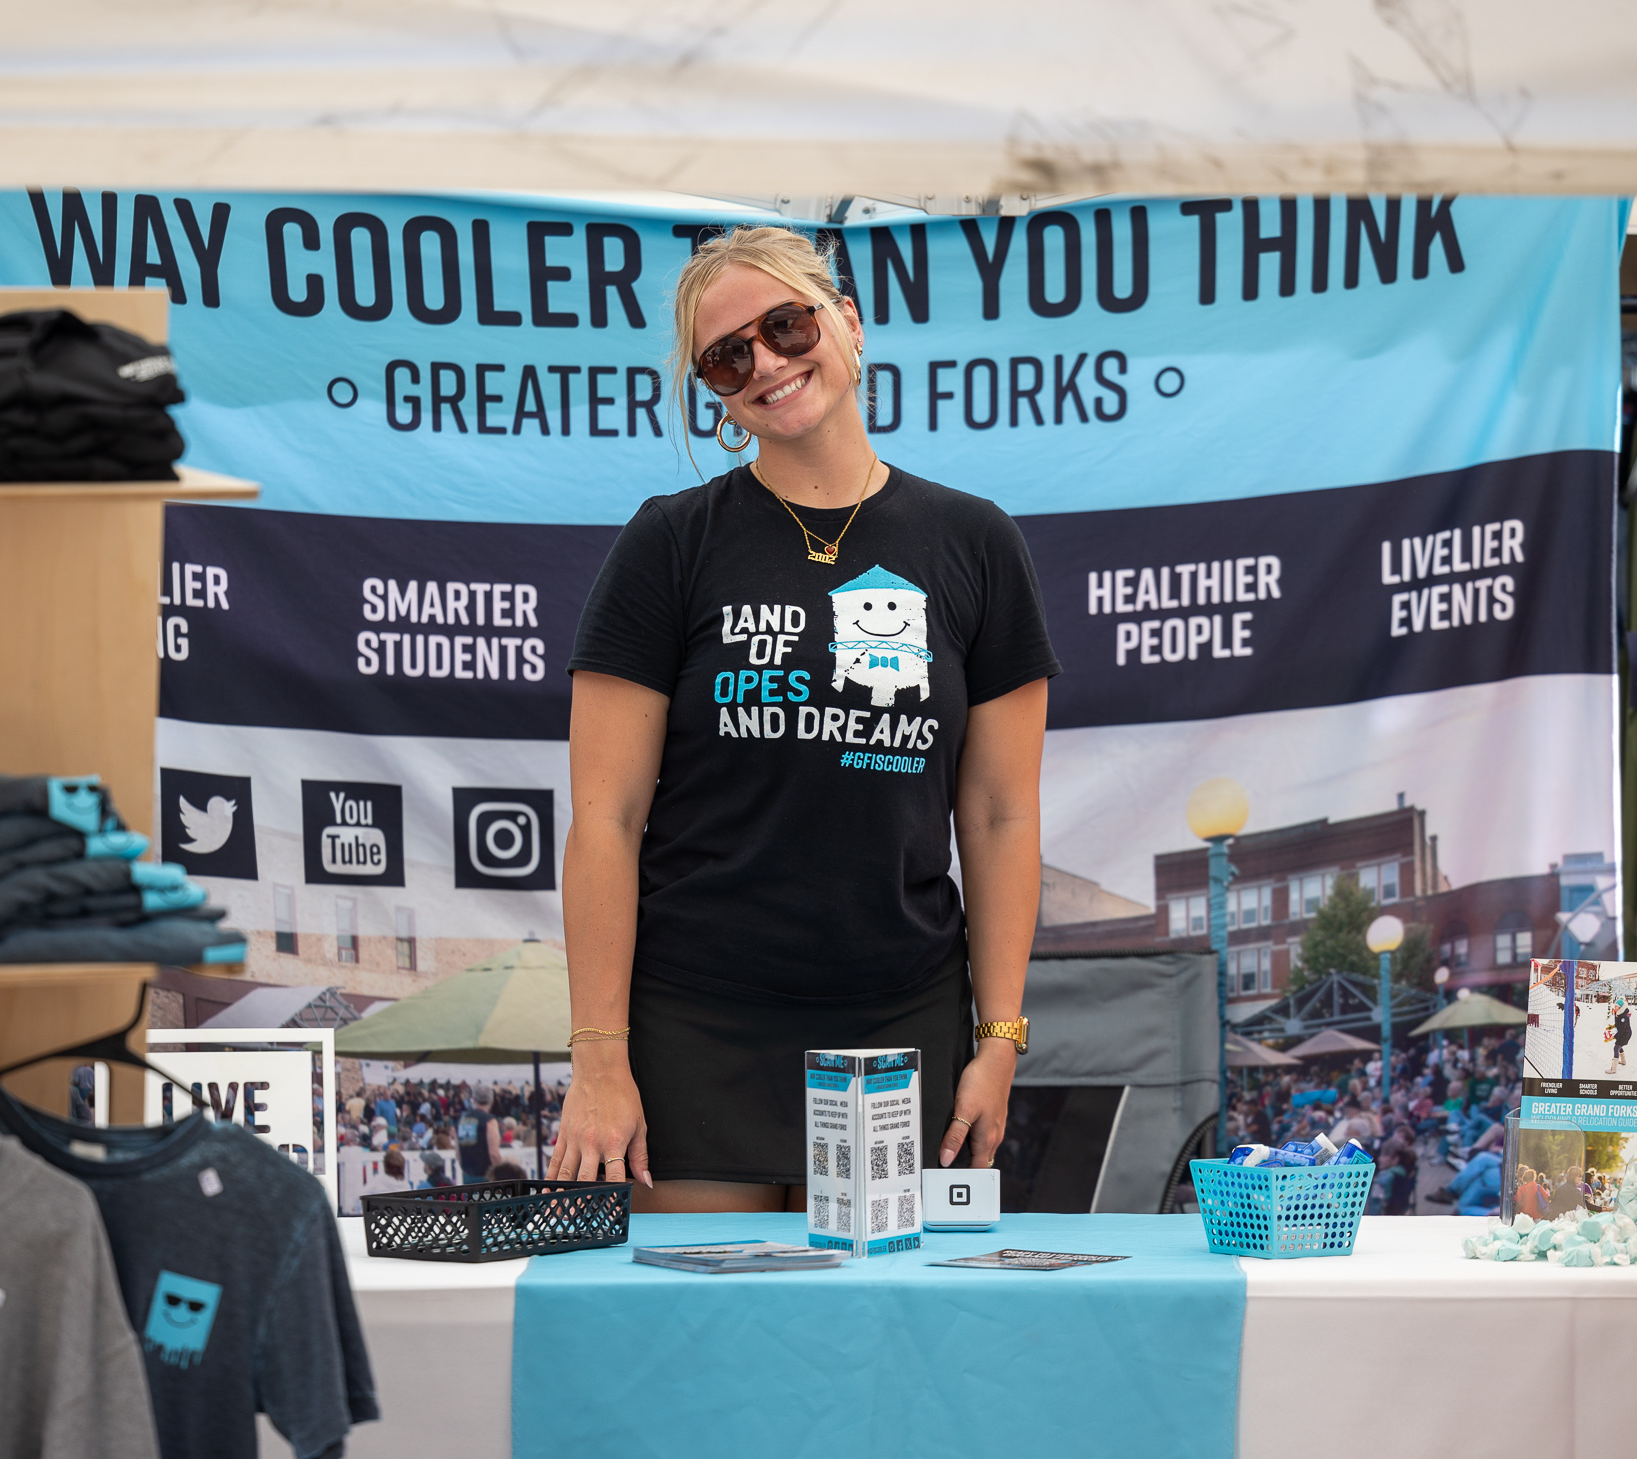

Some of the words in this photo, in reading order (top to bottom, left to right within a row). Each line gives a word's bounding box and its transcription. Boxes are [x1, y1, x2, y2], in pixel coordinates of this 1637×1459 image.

[25, 187, 231, 308] WAY
[264, 206, 647, 329] COOLER
[958, 204, 1150, 319] YOU
[1180, 193, 1466, 306] THINK
[384, 358, 663, 438] GREATER
[927, 349, 1129, 433] FORKS
[808, 551, 837, 565] 2002
[1380, 518, 1525, 585] LIVELIER
[362, 577, 539, 628] SMARTER
[1087, 555, 1282, 615] HEALTHIER
[722, 604, 806, 644] LAND
[1390, 575, 1515, 638] EVENTS
[357, 631, 546, 682] STUDENTS
[749, 634, 800, 666] OF
[1116, 612, 1254, 667] PEOPLE
[714, 670, 811, 703] OPES
[718, 706, 786, 739] AND
[797, 706, 939, 751] DREAMS
[840, 751, 926, 774] #GFISCOOLER
[329, 791, 373, 826] You
[326, 834, 382, 866] Tube
[835, 1055, 844, 1068] ME
[895, 1053, 904, 1067] ME
[1532, 1102, 1572, 1115] GREATER
[1575, 1103, 1606, 1116] GRAND
[1608, 1105, 1637, 1117] FORKS
[1578, 1116, 1617, 1126] RELOCATION
[1618, 1117, 1637, 1127] GUIDE
